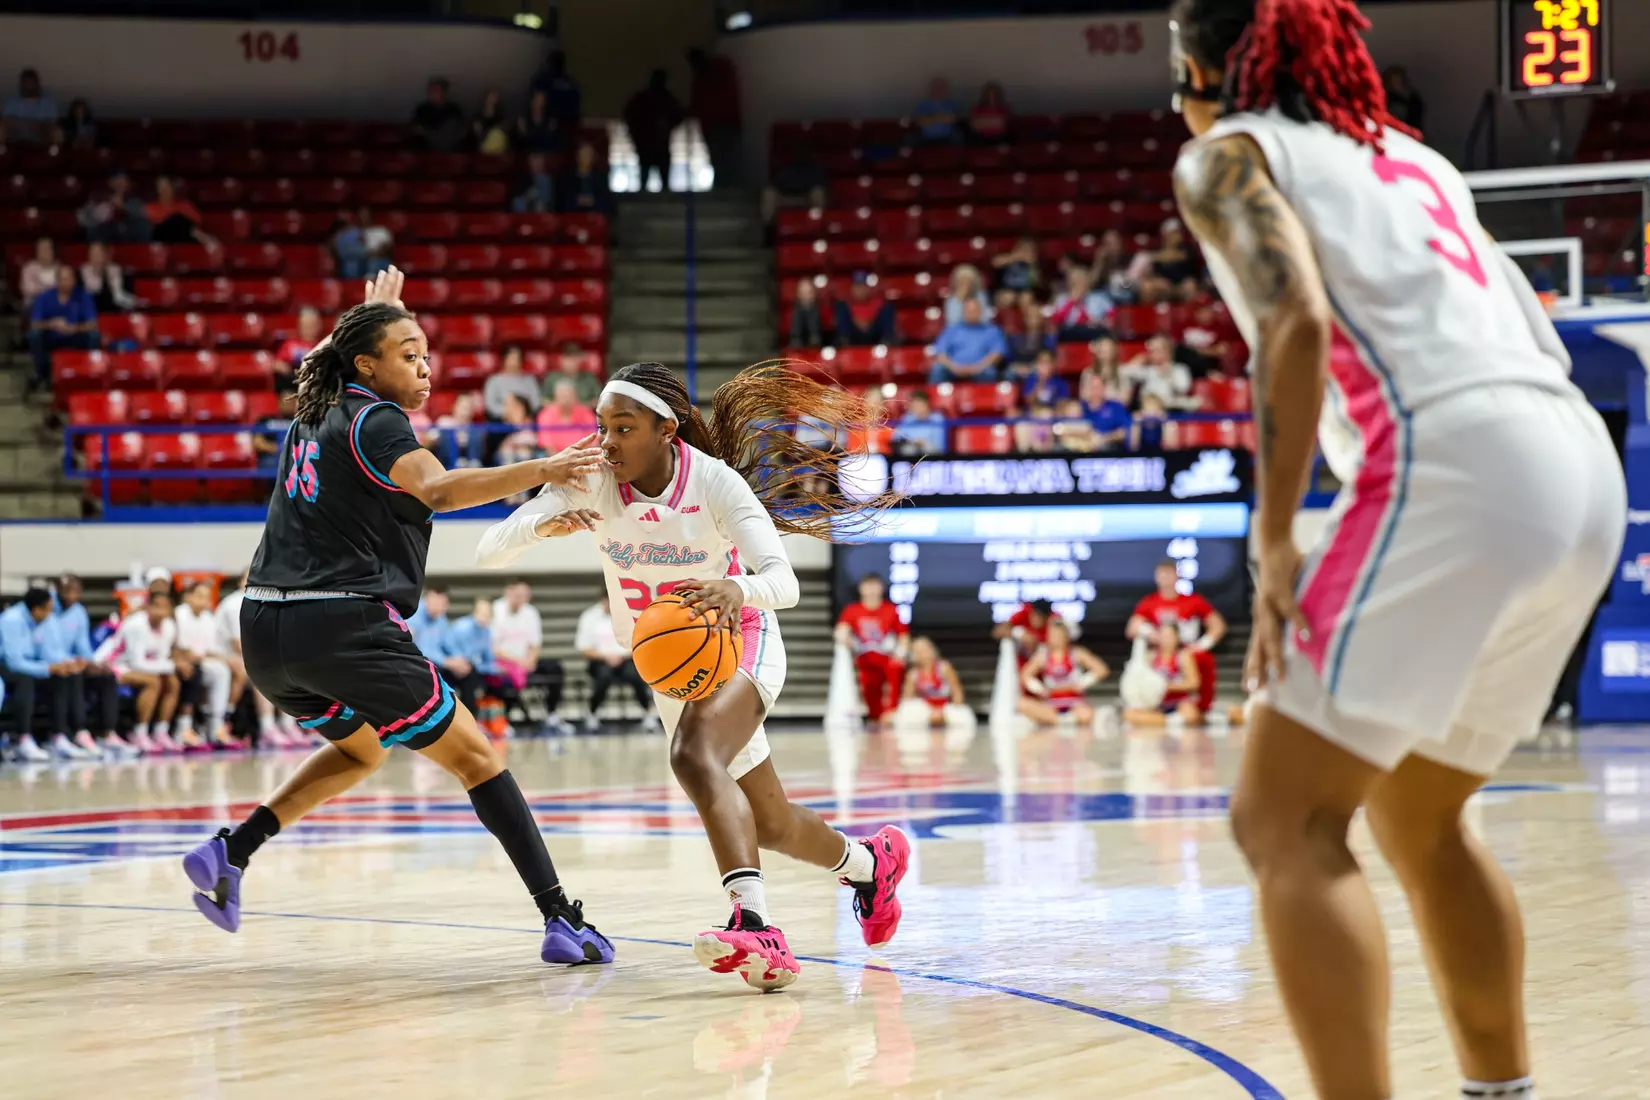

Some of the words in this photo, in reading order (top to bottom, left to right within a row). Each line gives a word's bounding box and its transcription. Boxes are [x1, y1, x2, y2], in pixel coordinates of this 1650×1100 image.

[1533, 0, 1599, 30] 7:27
[236, 31, 300, 63] 104
[1082, 21, 1144, 55] 105
[1523, 28, 1592, 87] 23
[1372, 155, 1488, 288] 3
[600, 538, 637, 570] Lady
[639, 542, 709, 566] Techsters
